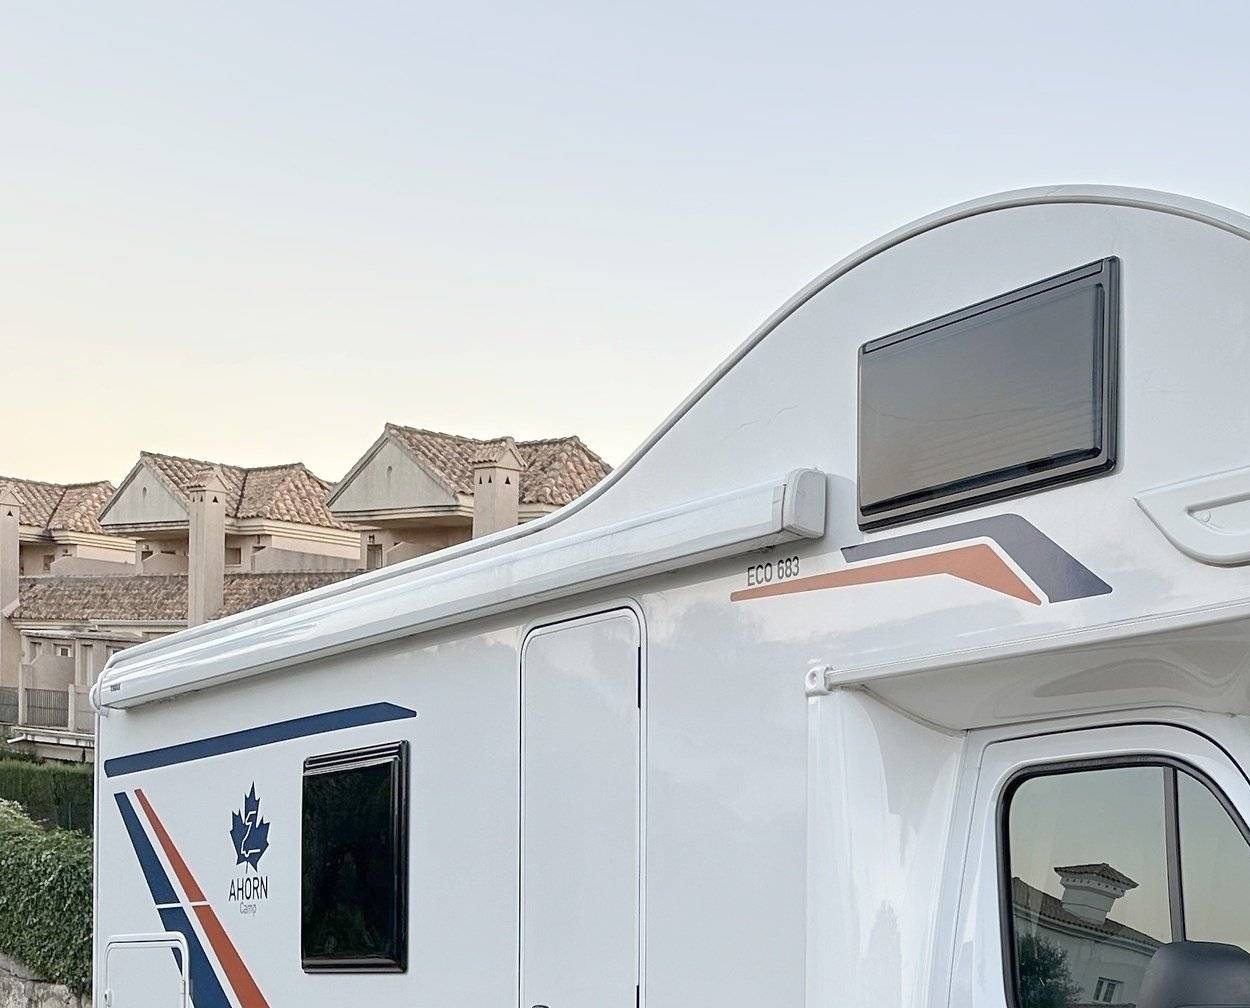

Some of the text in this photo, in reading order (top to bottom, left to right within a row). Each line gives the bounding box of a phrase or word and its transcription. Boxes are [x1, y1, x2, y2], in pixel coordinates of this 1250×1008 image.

[747, 555, 800, 587] ECO 683
[228, 875, 269, 902] AHORN
[240, 901, 257, 917] Camp
